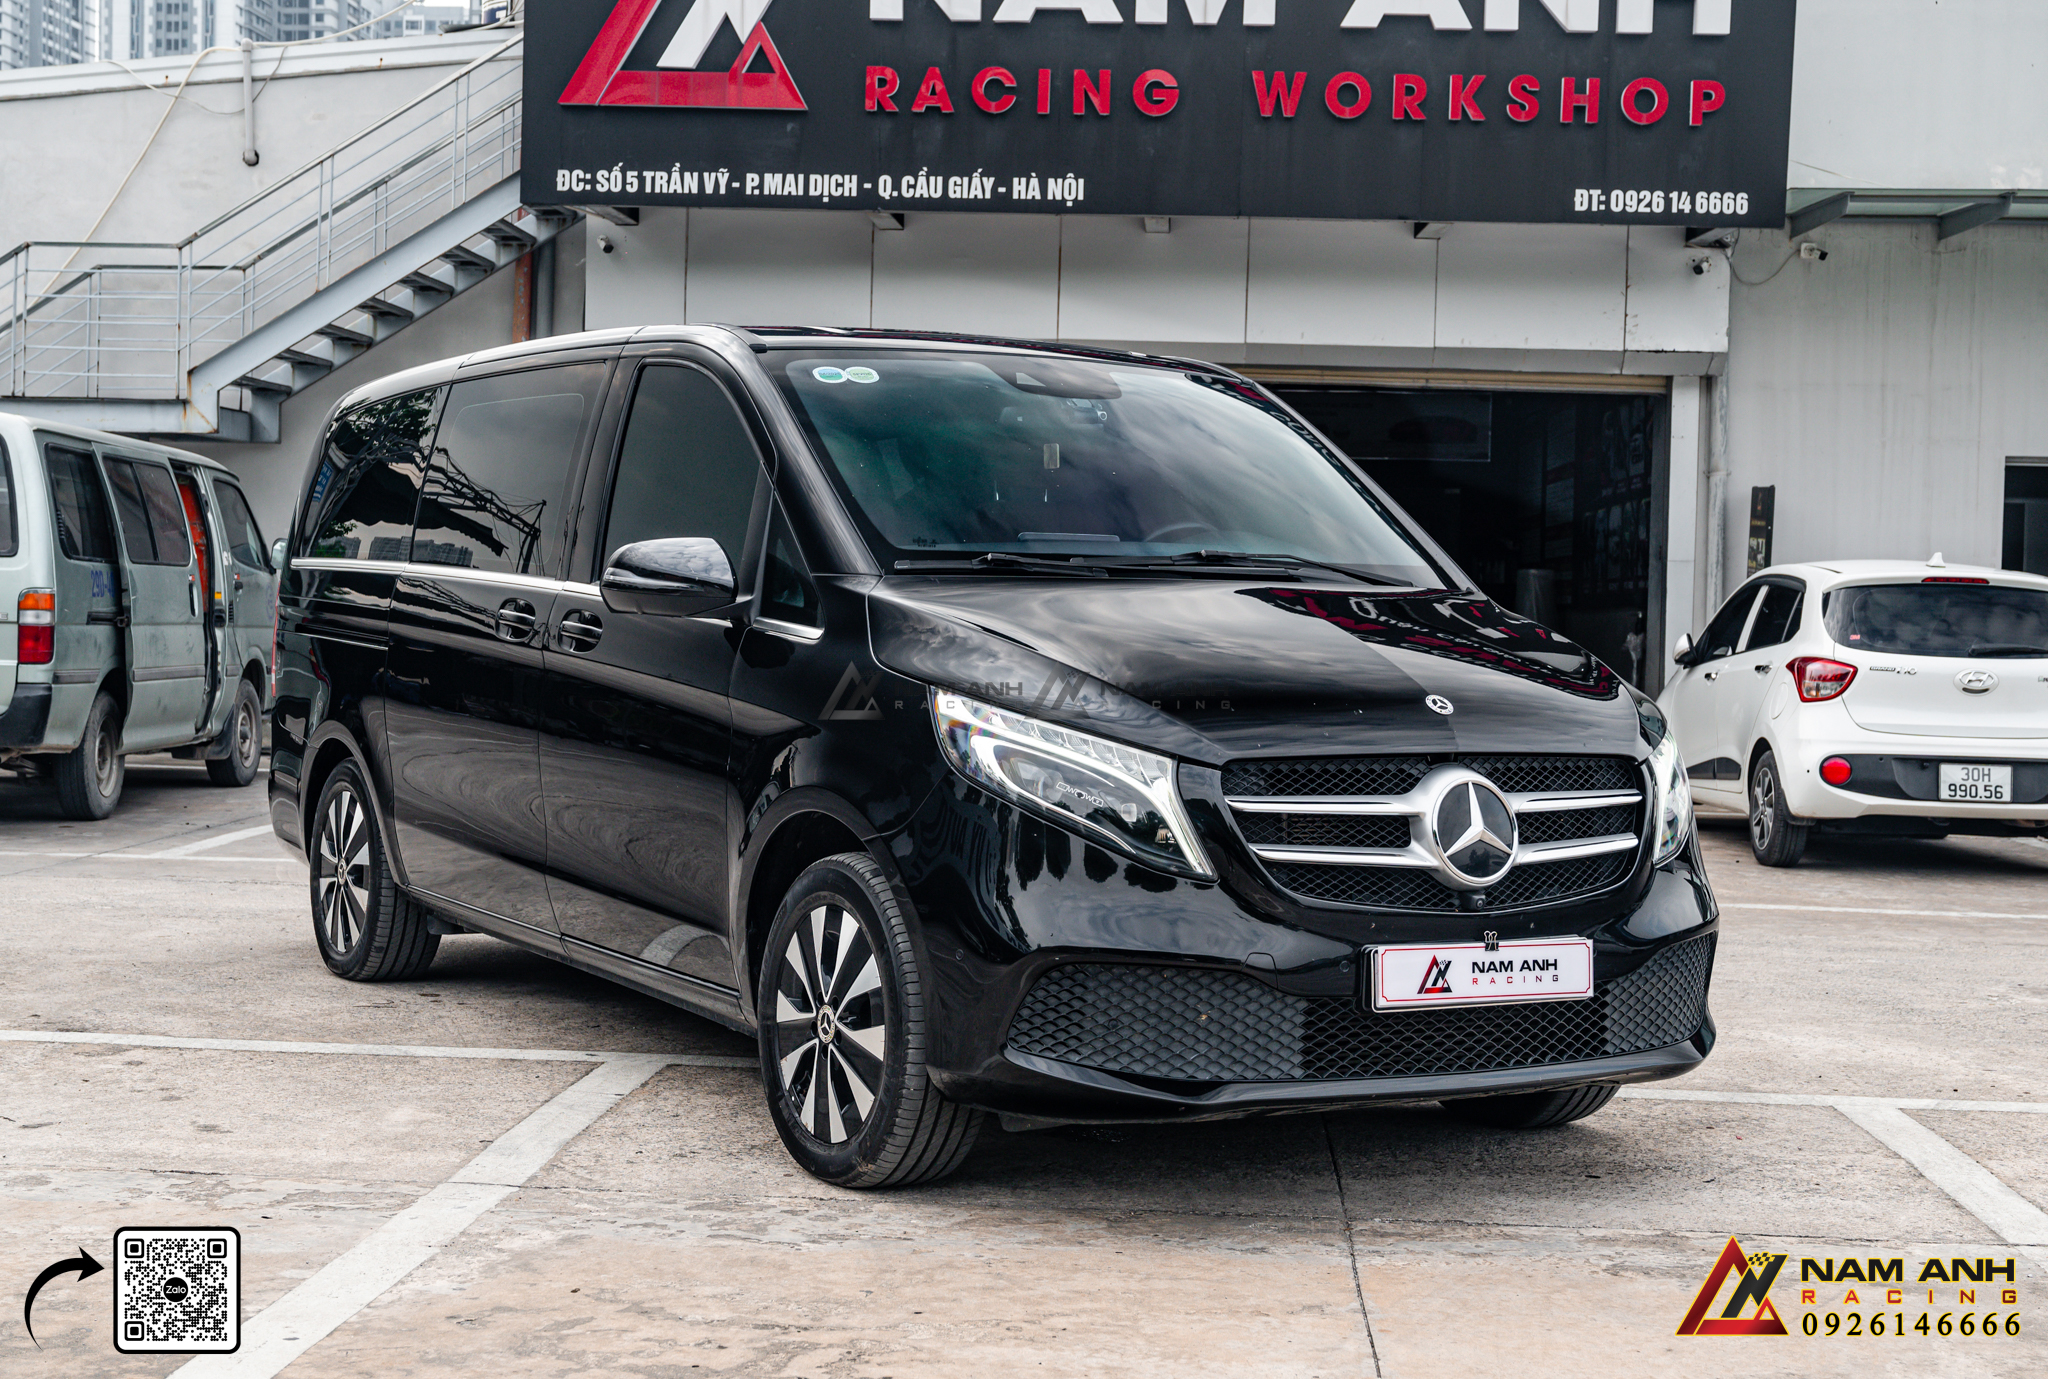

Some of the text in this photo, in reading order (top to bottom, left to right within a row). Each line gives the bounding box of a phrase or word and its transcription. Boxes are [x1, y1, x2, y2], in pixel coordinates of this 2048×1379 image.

[864, 65, 1727, 127] RACING WORKSHOP
[556, 169, 592, 192] ĐC:
[596, 162, 623, 193] SỐ
[625, 171, 639, 193] 5
[643, 162, 699, 194] TRẦN
[703, 168, 730, 195] VỸ
[808, 174, 858, 203] DỊCH
[947, 168, 996, 199] GIẤY
[1012, 172, 1042, 200] HÀ
[1047, 172, 1085, 207] NỘI
[1574, 188, 1749, 215] ĐT: 0926 14 6666
[1961, 766, 1991, 783] 30H
[1948, 783, 2004, 800] 990.56
[1471, 958, 1558, 974] NAM ANH
[1472, 974, 1559, 985] RACING
